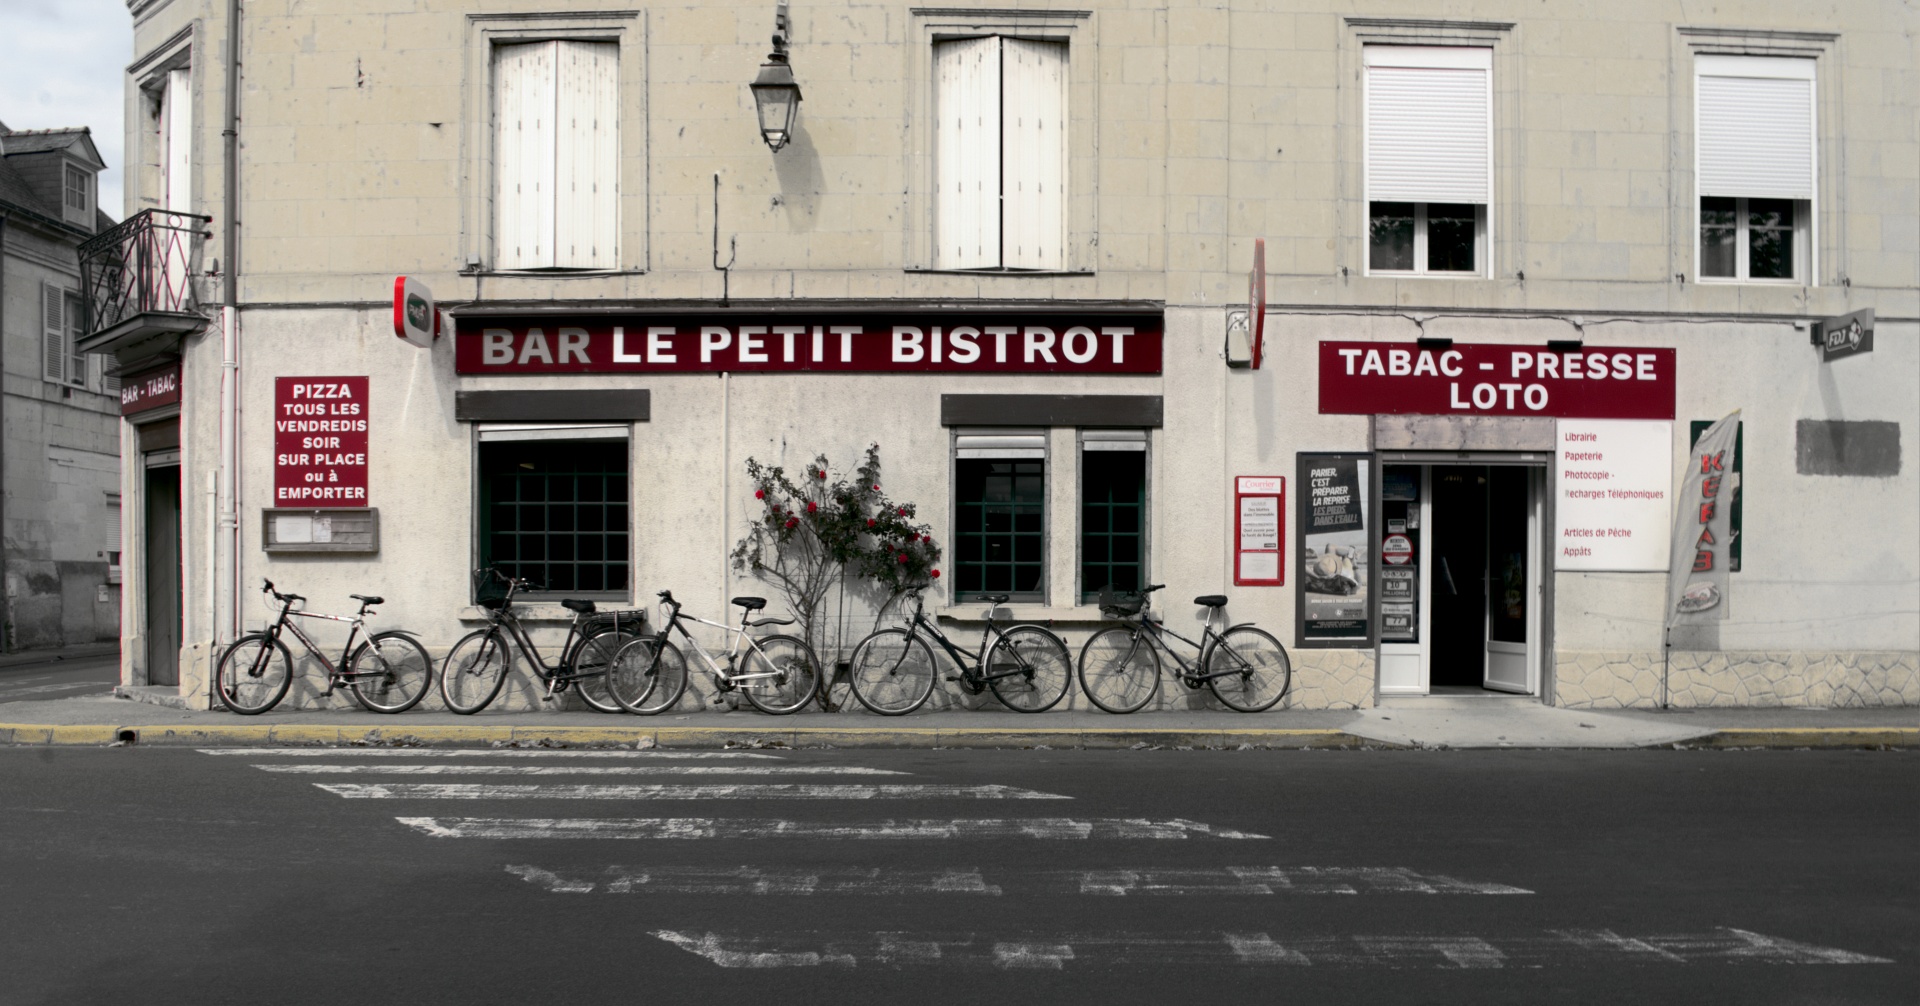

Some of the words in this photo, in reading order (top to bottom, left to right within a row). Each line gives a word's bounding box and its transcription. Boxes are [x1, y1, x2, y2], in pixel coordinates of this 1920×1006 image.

[482, 327, 592, 365] BAR
[613, 326, 677, 363] LE
[700, 325, 863, 363] PETIT
[891, 325, 1135, 364] BISTROT
[1338, 348, 1463, 377] TABAC
[1479, 362, 1494, 370] -
[1511, 351, 1657, 381] PRESSE
[122, 385, 139, 405] BAR
[147, 373, 176, 397] TABAC
[293, 383, 353, 399] PIZZA
[1450, 382, 1549, 411] LOTO
[283, 403, 326, 416] TOUS
[331, 403, 361, 415] LES
[276, 420, 368, 433] VENDREDIS
[302, 436, 341, 449] SOIR
[1564, 432, 1597, 442] Librairie
[278, 453, 310, 466] SUR
[314, 453, 366, 466] PLACE
[1564, 451, 1603, 462] Papeterie
[304, 472, 324, 482] ou
[328, 468, 339, 482] à
[1310, 467, 1337, 478] PARIER,
[1564, 470, 1610, 481] Photocopie
[1245, 480, 1275, 489] Courrier
[1311, 478, 1331, 487] C'EST
[278, 486, 366, 499] EMPORTER
[1565, 489, 1606, 500] Recharges
[1607, 488, 1664, 500] Téléphoniques
[1313, 497, 1321, 506] LA
[1323, 495, 1351, 505] REPRISE
[1313, 506, 1326, 516] LES
[1326, 505, 1347, 516] PIEDS
[1313, 515, 1334, 526] DANS
[1563, 528, 1594, 538] Articles
[1595, 528, 1606, 538] de
[1607, 527, 1632, 538] Pêche
[1563, 546, 1592, 558] Appâts
